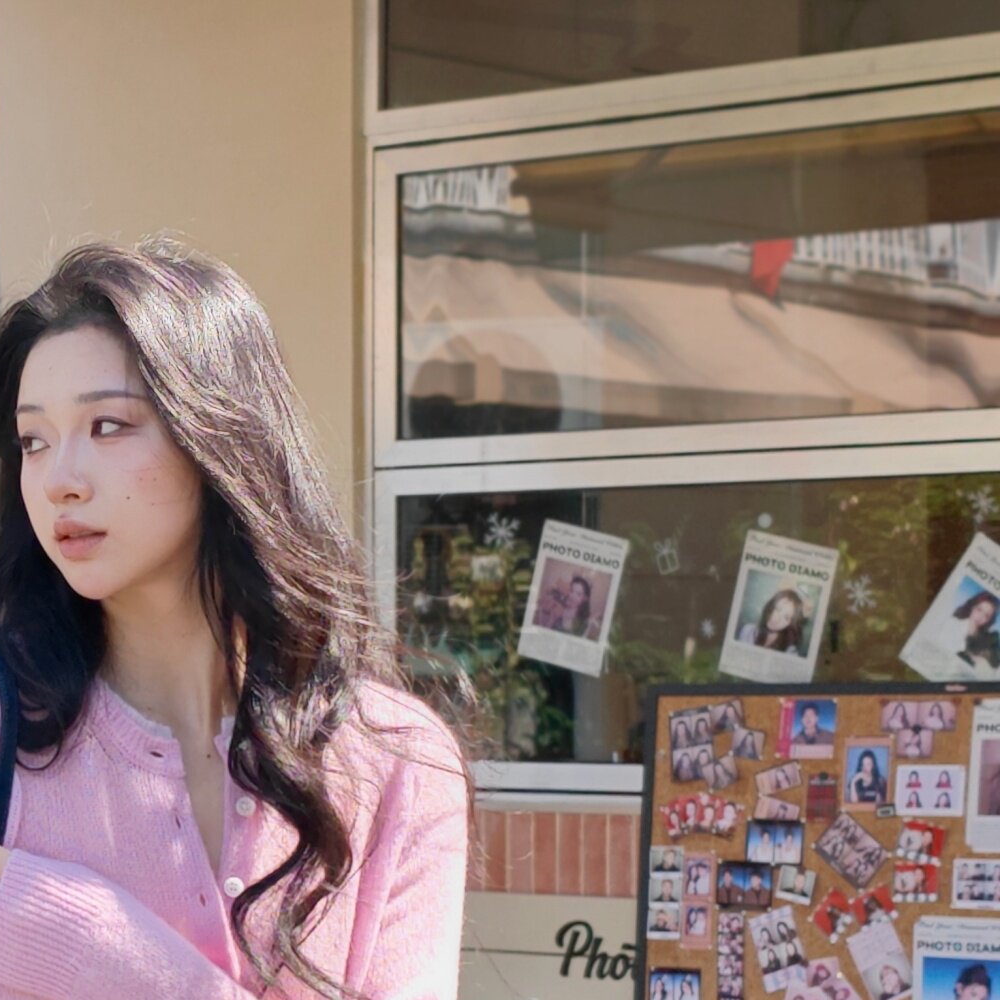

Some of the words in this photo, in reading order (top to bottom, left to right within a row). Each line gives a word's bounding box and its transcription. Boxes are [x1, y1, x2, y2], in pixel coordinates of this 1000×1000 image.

[542, 541, 581, 559] PHOTO
[745, 553, 786, 571] PHOTO
[555, 920, 637, 981] Pho
[917, 940, 962, 952] PHOTO
